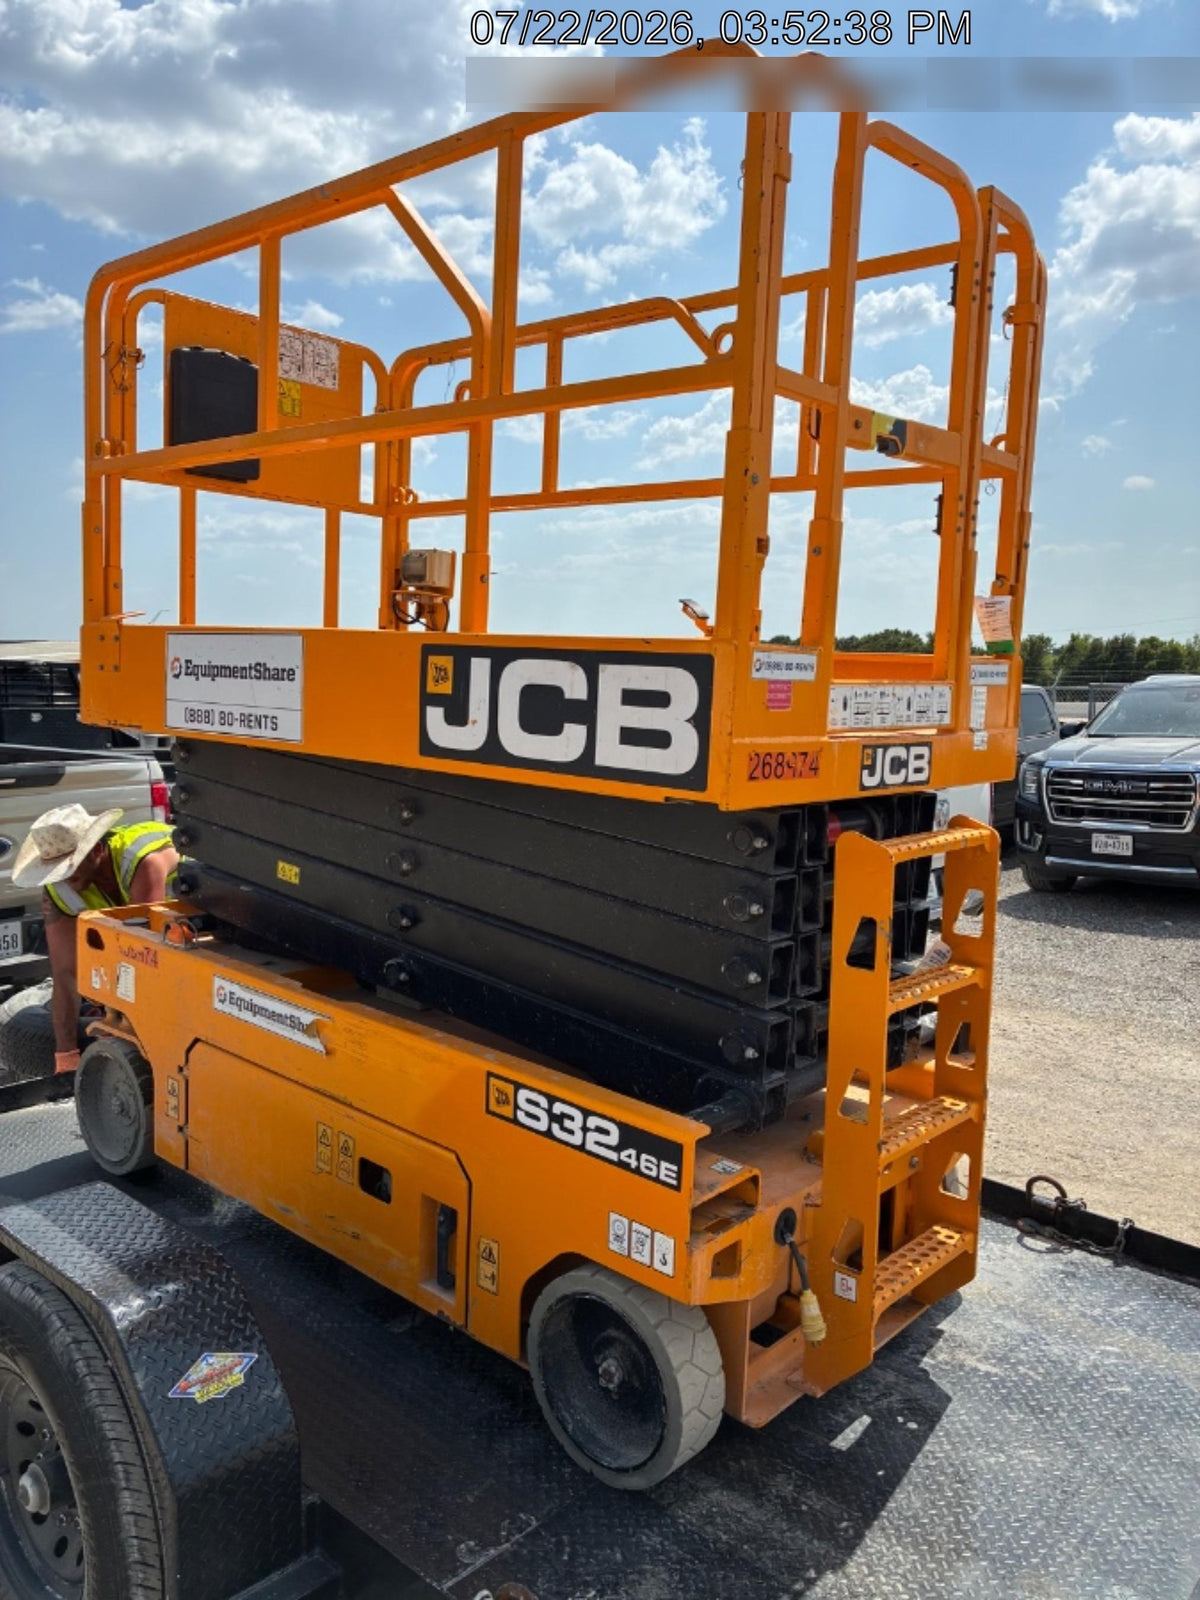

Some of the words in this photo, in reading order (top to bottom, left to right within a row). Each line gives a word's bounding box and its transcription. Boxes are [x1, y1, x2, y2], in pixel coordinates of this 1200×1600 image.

[184, 659, 296, 681] EquipmentShare
[184, 706, 215, 726] (888)
[426, 656, 700, 776] JCB
[861, 746, 930, 787] JCB
[228, 990, 307, 1033] EquipmentSh
